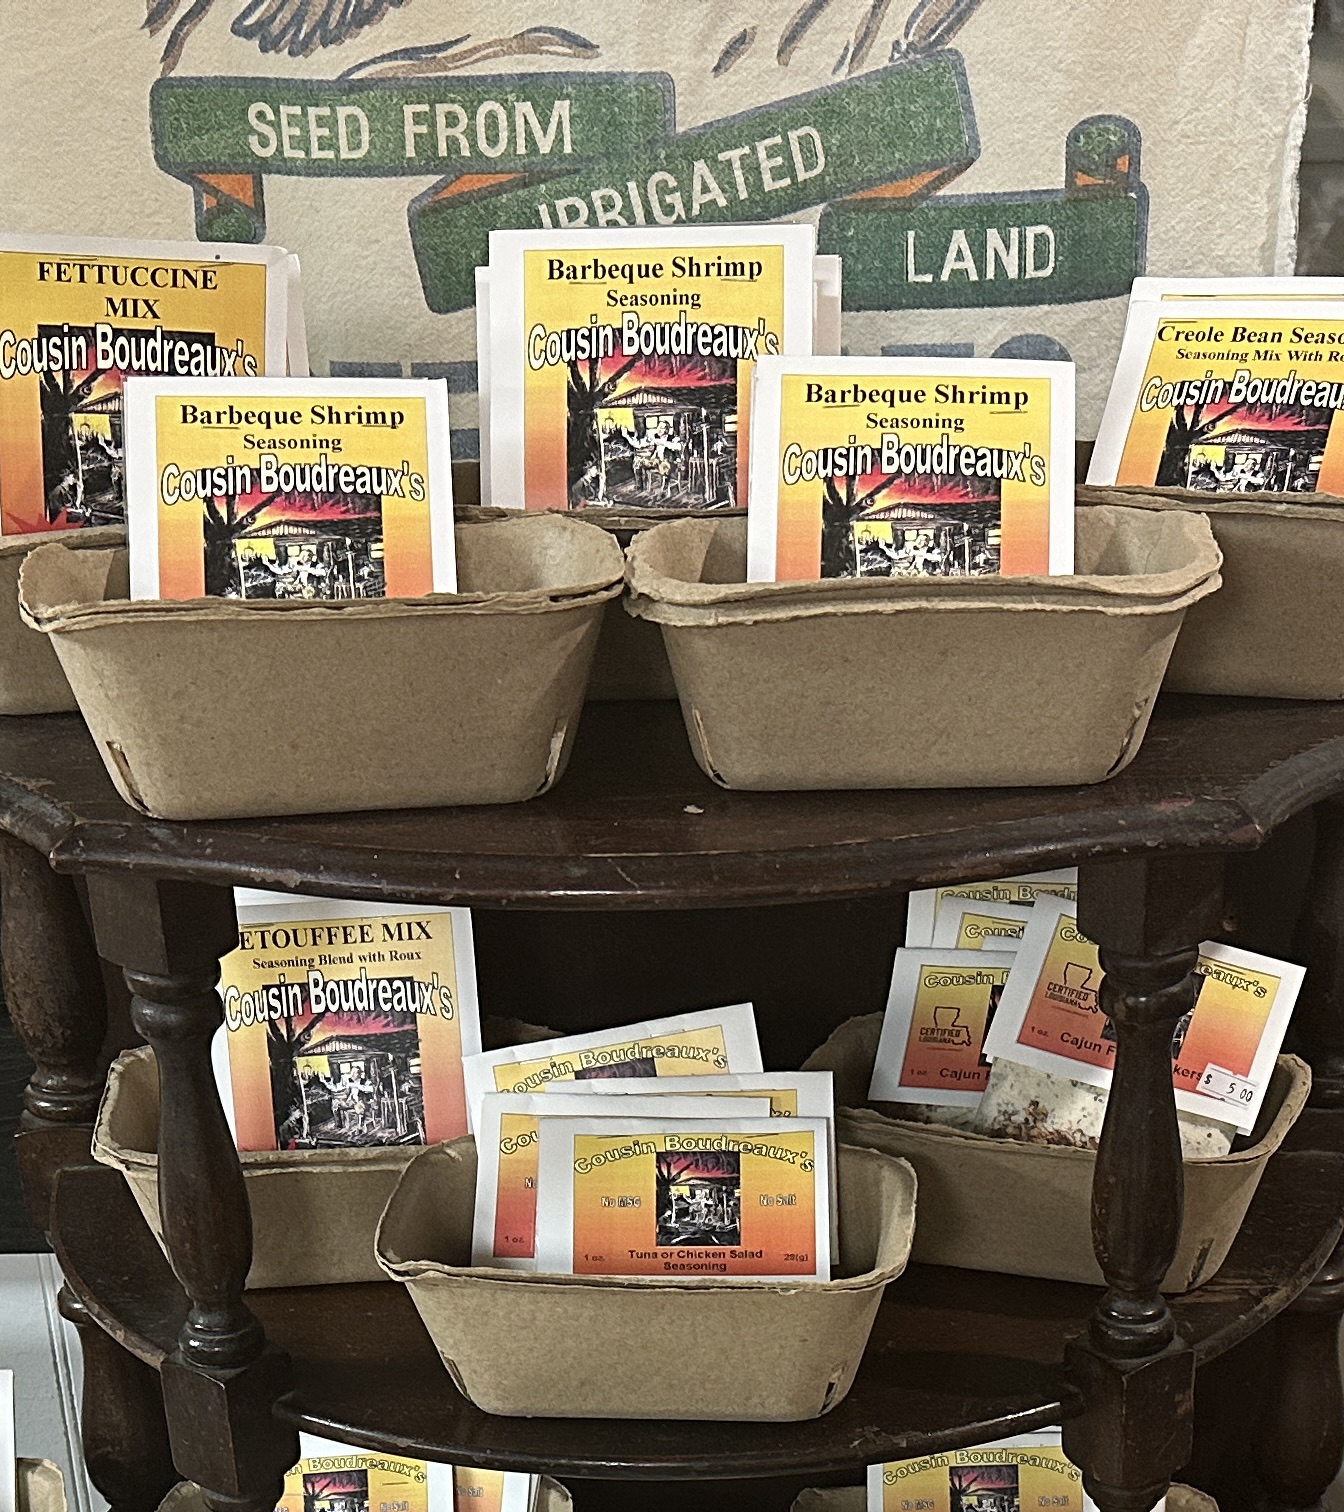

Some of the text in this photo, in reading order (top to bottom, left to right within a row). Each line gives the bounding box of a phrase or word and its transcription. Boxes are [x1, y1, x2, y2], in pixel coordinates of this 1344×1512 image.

[247, 100, 573, 160] SEED FROM
[906, 224, 1056, 283] LAND
[36, 260, 219, 291] FETTUCCINE
[546, 256, 764, 285] Barbeque Shrimp
[104, 296, 162, 320] MIX
[605, 286, 702, 310] Seasoning
[528, 311, 780, 371] Cousin Boudreaux's
[1157, 324, 1225, 346] Creole
[1230, 325, 1284, 345] Bean
[95, 323, 258, 378] Boudreaux's
[1175, 346, 1249, 365] Seasoning
[1253, 347, 1282, 362] Mix
[1288, 349, 1321, 363] With
[804, 382, 1030, 410] Barbeque Shrimp
[1140, 370, 1224, 414] Cousin
[179, 404, 405, 429] Barbeque Shrimp
[865, 410, 966, 435] Seasoning
[242, 433, 343, 453] Seasoning
[783, 432, 1046, 487] Cousin Boudreaux's
[161, 453, 426, 506] Cousin Boudreaux's
[238, 919, 434, 951] ETOUFFEE MIX
[252, 948, 423, 972] Seasoning Blend with Roux
[923, 970, 995, 989] Cousin
[1046, 981, 1090, 1002] CERTIFIED
[223, 968, 455, 1032] Cousin Boudreaux's
[919, 1026, 962, 1037] CERTIFIED
[1059, 1031, 1103, 1053] Cajun
[579, 1042, 729, 1070] Boudreaux's
[939, 1067, 981, 1081] Cajun
[1226, 1082, 1254, 1103] 5 00
[573, 1139, 657, 1175] Cousin
[664, 1134, 816, 1174] Boudreaux's
[628, 1248, 764, 1260] Tuna or Chicken Salad
[663, 1261, 728, 1273] Seasoning
[308, 1456, 427, 1484] Boudreaux's
[883, 1449, 1081, 1486] Cousin Boudreaux's
